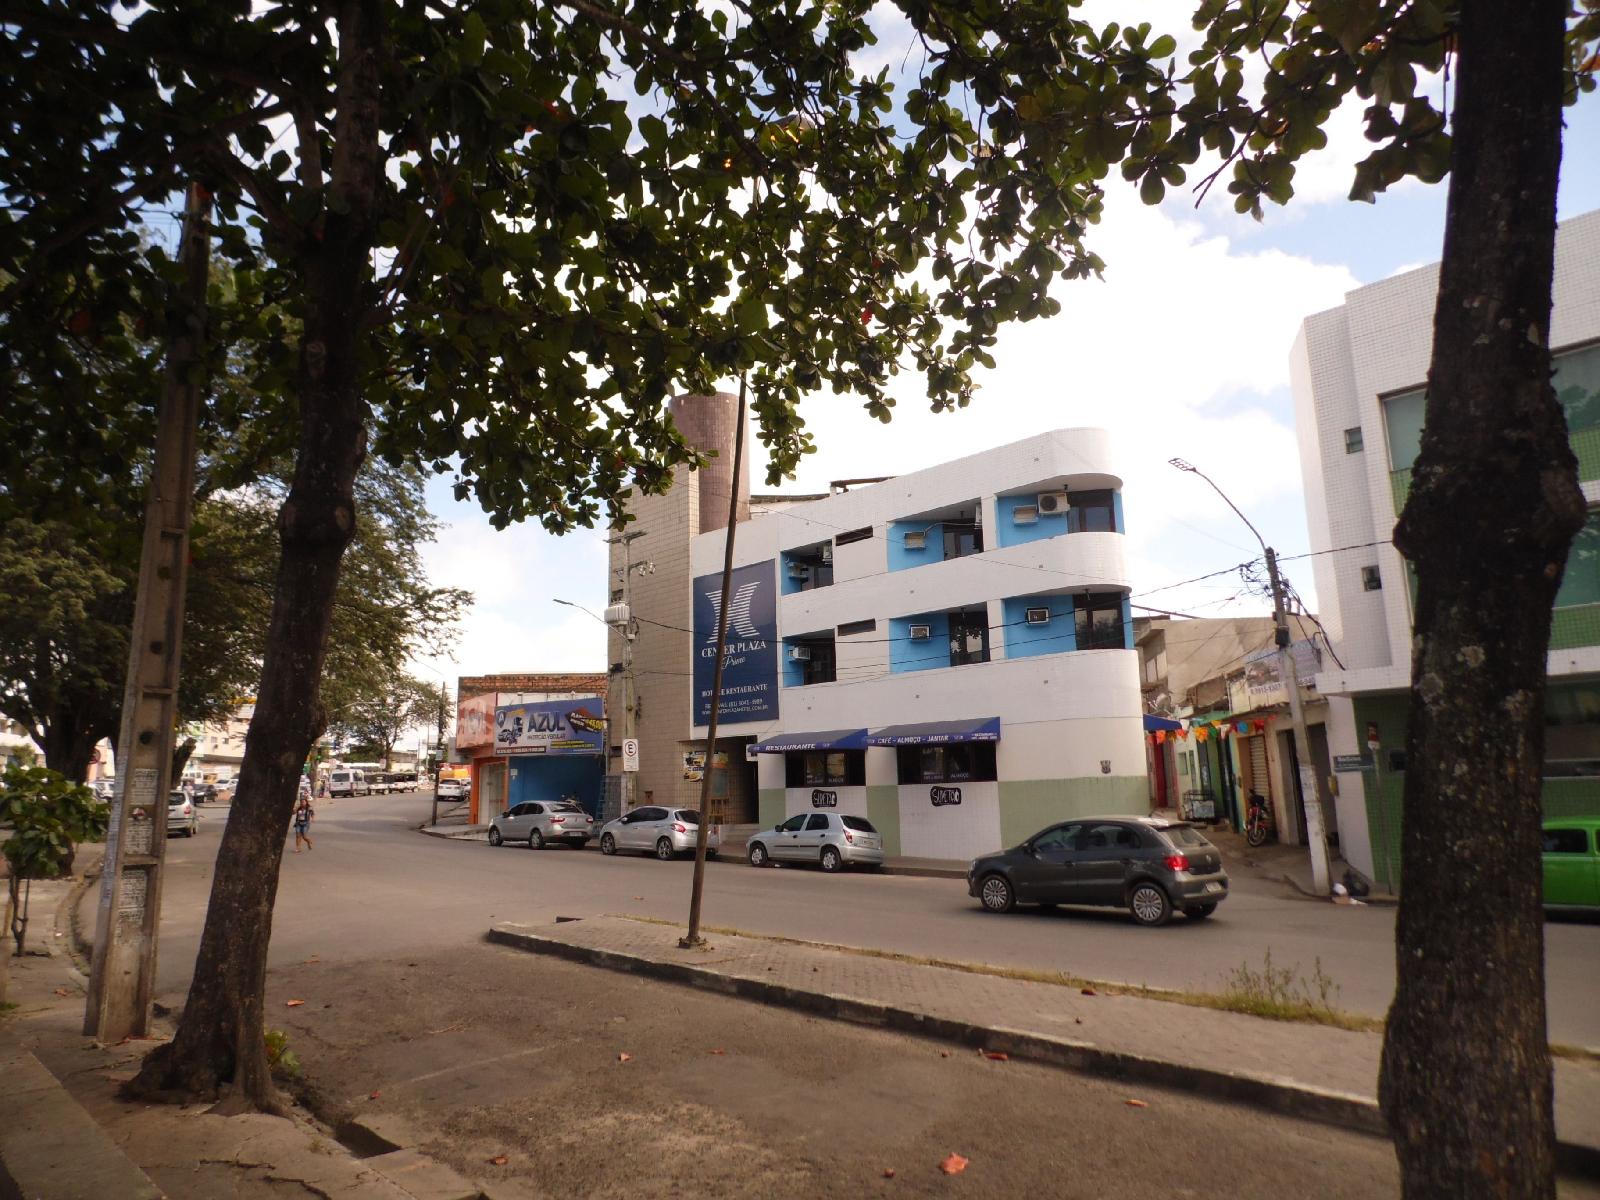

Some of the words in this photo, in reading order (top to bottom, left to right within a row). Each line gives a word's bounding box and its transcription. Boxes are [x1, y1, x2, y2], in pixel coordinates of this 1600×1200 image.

[702, 644, 735, 658] CENER
[737, 640, 766, 653] PLAZA
[726, 683, 768, 696] RESTAURANTE
[528, 711, 566, 733] AZUL
[765, 743, 816, 751] RESTAURANTE
[877, 736, 892, 744] CAFÉ
[897, 736, 921, 745] ALMOÇO
